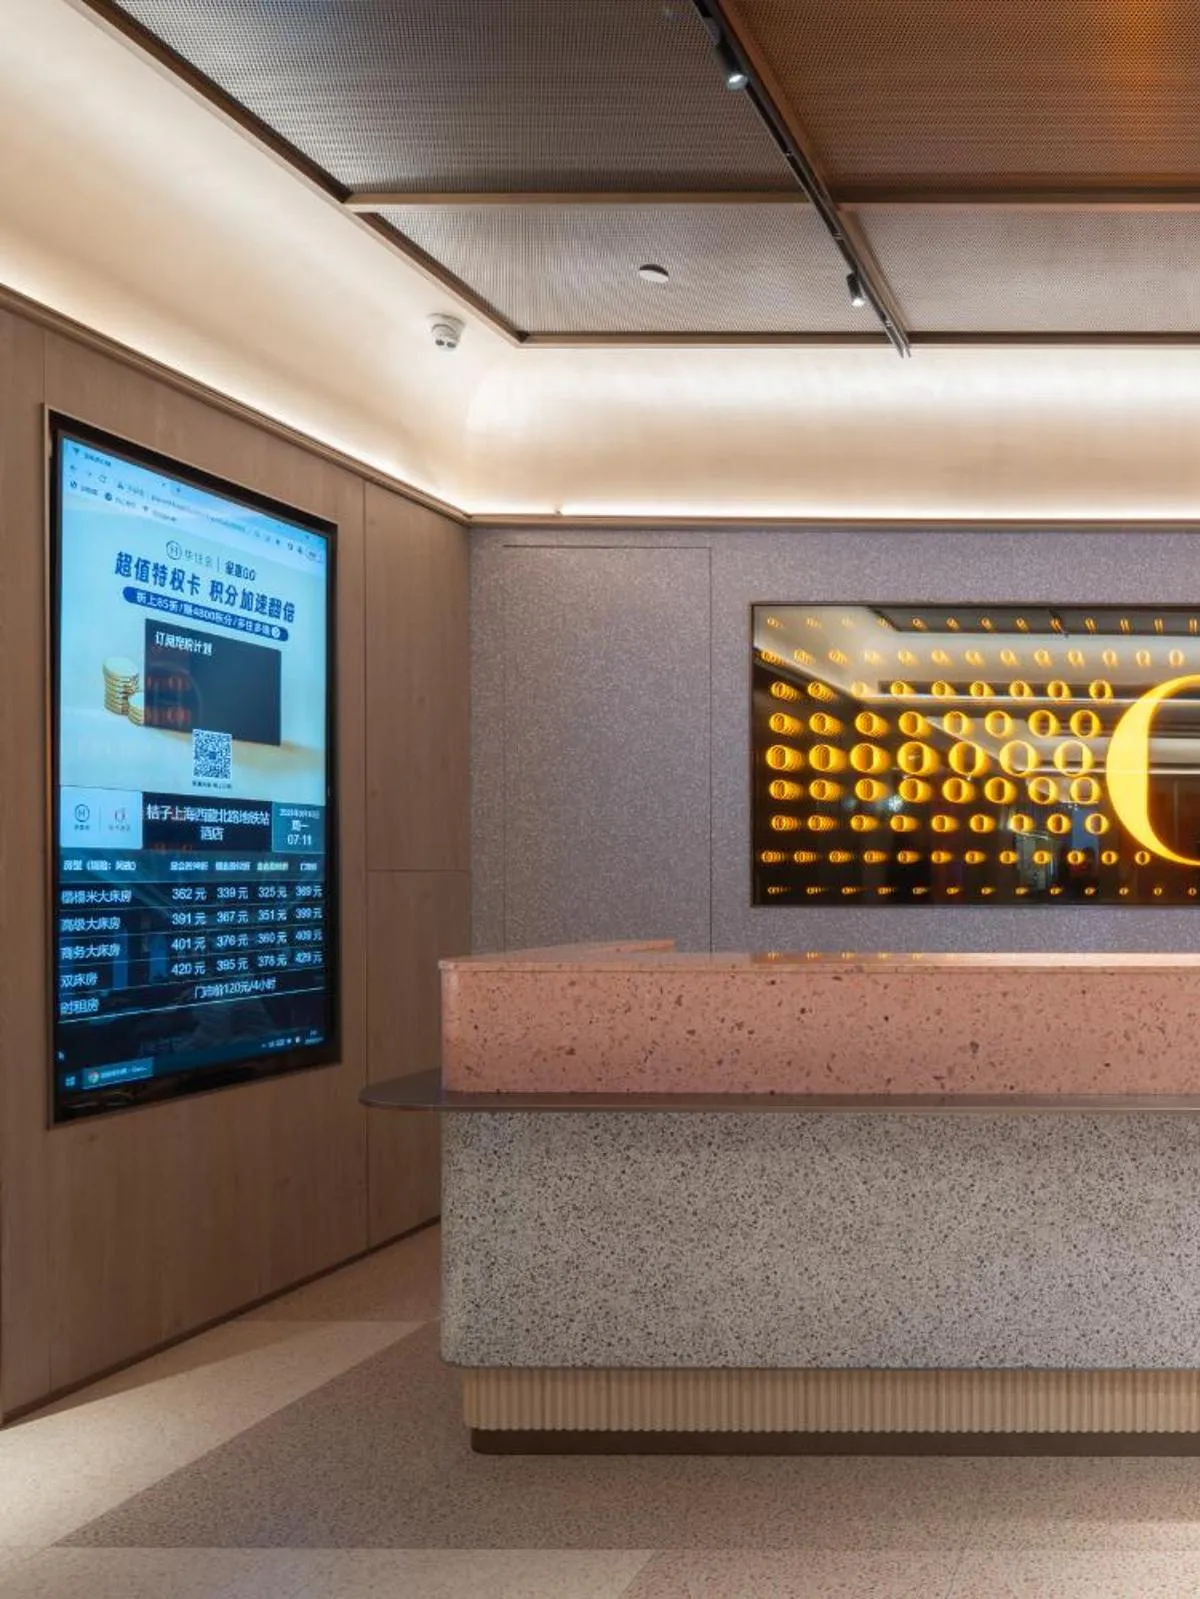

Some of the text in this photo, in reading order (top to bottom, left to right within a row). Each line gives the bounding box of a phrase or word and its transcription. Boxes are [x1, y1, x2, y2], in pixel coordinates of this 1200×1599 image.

[115, 551, 296, 623] 超值特权卡 积分加速翻倍
[200, 826, 224, 841] 酒店
[287, 834, 312, 845] 07:11
[258, 886, 276, 898] 325
[171, 913, 191, 925] 391
[171, 938, 191, 950] 401
[60, 972, 98, 988] 双床房
[171, 963, 192, 976] 420
[216, 959, 236, 971] 395
